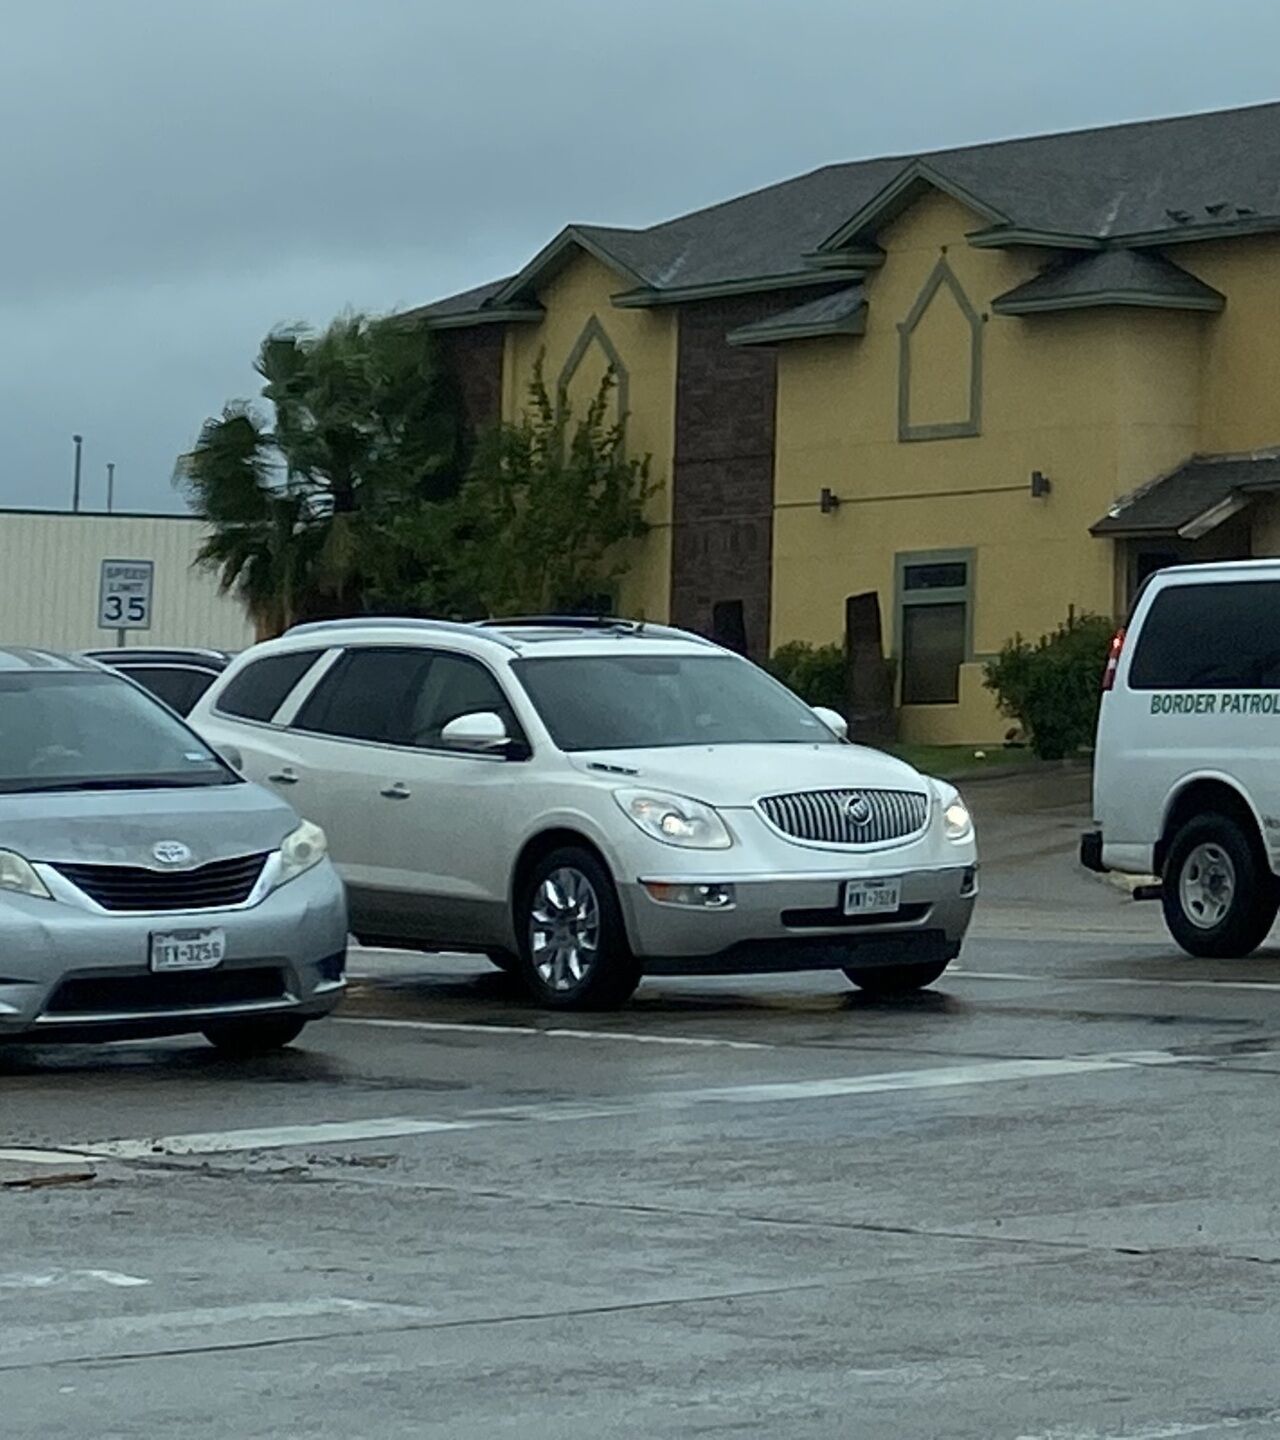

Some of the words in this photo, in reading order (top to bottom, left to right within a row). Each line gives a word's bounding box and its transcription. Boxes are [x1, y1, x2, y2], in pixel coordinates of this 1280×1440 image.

[106, 568, 150, 579] SPEED
[104, 596, 145, 621] 35
[1150, 694, 1217, 714] BORDER
